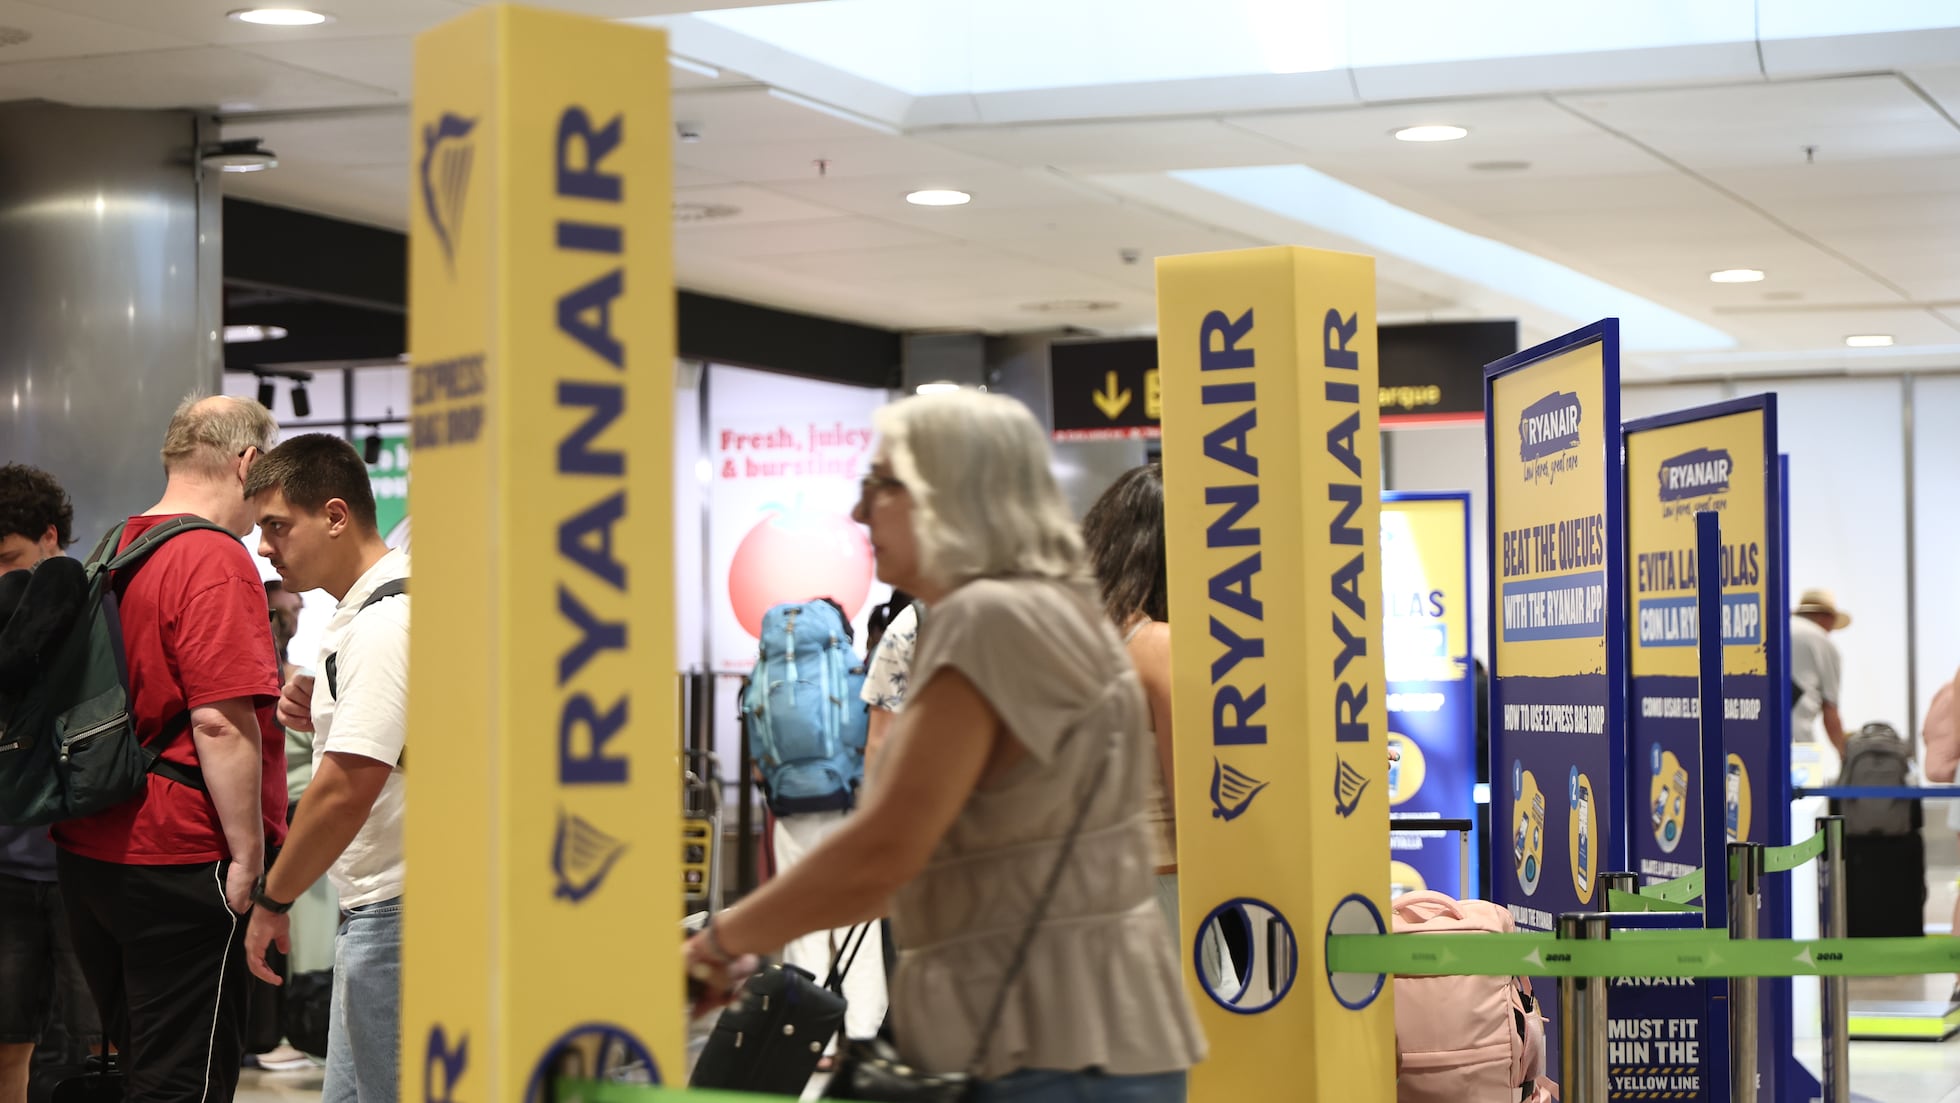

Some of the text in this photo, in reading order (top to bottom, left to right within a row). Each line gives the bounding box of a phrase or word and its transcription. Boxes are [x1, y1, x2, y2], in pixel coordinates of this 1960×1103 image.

[1529, 405, 1578, 446] RYANAIR
[555, 104, 629, 785] RYANAIR
[721, 458, 737, 479] &
[1669, 459, 1728, 490] RYANAIR
[1200, 307, 1267, 746] RYANAIR
[1324, 308, 1369, 743] RYANAIR
[1503, 513, 1603, 577] BEAT THE QUEUES
[1638, 542, 1759, 592] EVITA LA OLAS
[1390, 590, 1445, 618] LAS
[1504, 584, 1602, 630] WITH THE RYANAIR APP
[1640, 607, 1664, 641] CON
[1664, 606, 1680, 640] LA
[1733, 603, 1758, 638] APP
[1504, 704, 1604, 735] HOW TO USE EXPRESS BAG DROP
[1572, 775, 1578, 801] 2
[1545, 952, 1572, 962] aena
[1816, 951, 1844, 961] aena
[1608, 1019, 1698, 1039] MUST FIT
[1608, 1041, 1699, 1064] HIN THE
[1615, 1076, 1668, 1090] YELLOW
[1671, 1076, 1699, 1090] LINE
